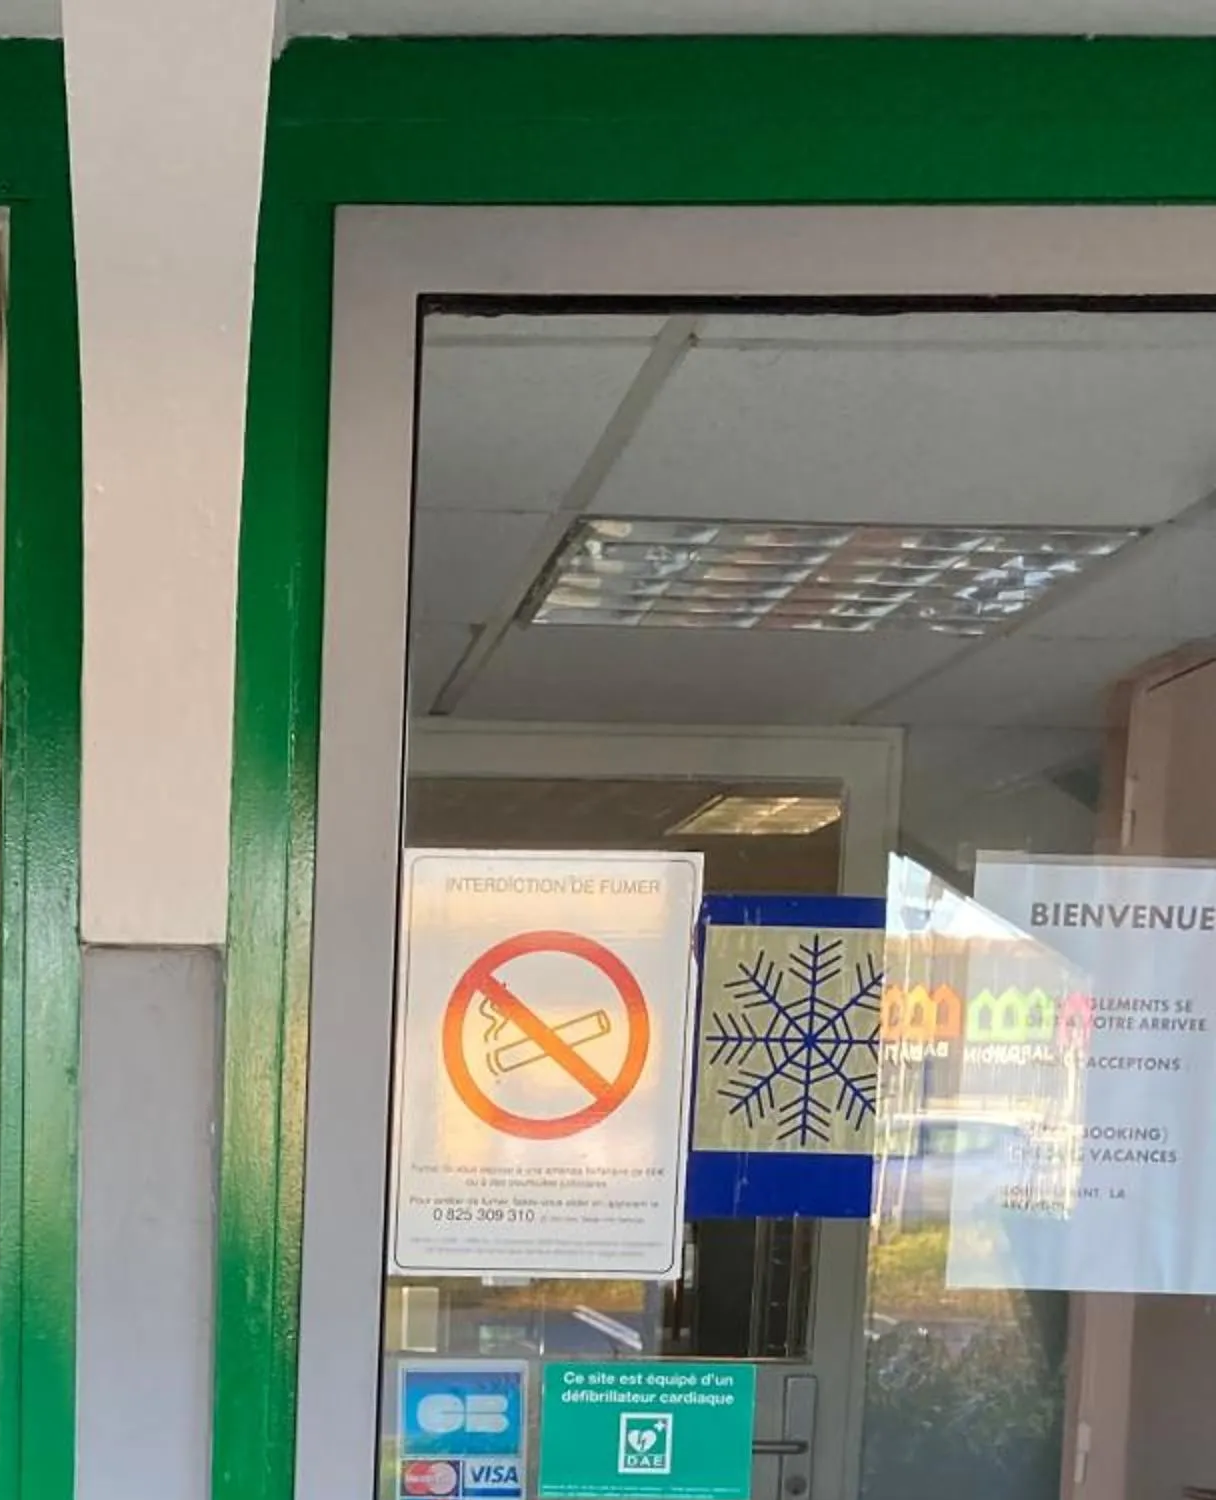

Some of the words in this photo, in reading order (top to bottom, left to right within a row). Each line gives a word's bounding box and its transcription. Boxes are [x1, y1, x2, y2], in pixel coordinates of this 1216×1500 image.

[445, 877, 568, 896] INTERDICTION
[572, 879, 595, 895] DE
[598, 878, 661, 895] FUMER
[1030, 902, 1215, 931] BIENVENUE
[1174, 998, 1193, 1014] SE
[1086, 1056, 1182, 1072] ACCEPTONS
[1089, 1148, 1178, 1164] VACANCES
[433, 1207, 443, 1221] 0
[445, 1207, 473, 1221] 825
[476, 1207, 505, 1222] 309
[507, 1208, 536, 1223] 310
[563, 1371, 585, 1385] Ce
[587, 1371, 616, 1386] site
[619, 1373, 642, 1386] est
[645, 1373, 697, 1390] équipé
[700, 1373, 734, 1387] d'un
[561, 1389, 659, 1404] défibrillateur
[659, 1391, 735, 1406] cardiaque
[626, 1455, 664, 1468] DAE
[470, 1465, 519, 1484] VISA
